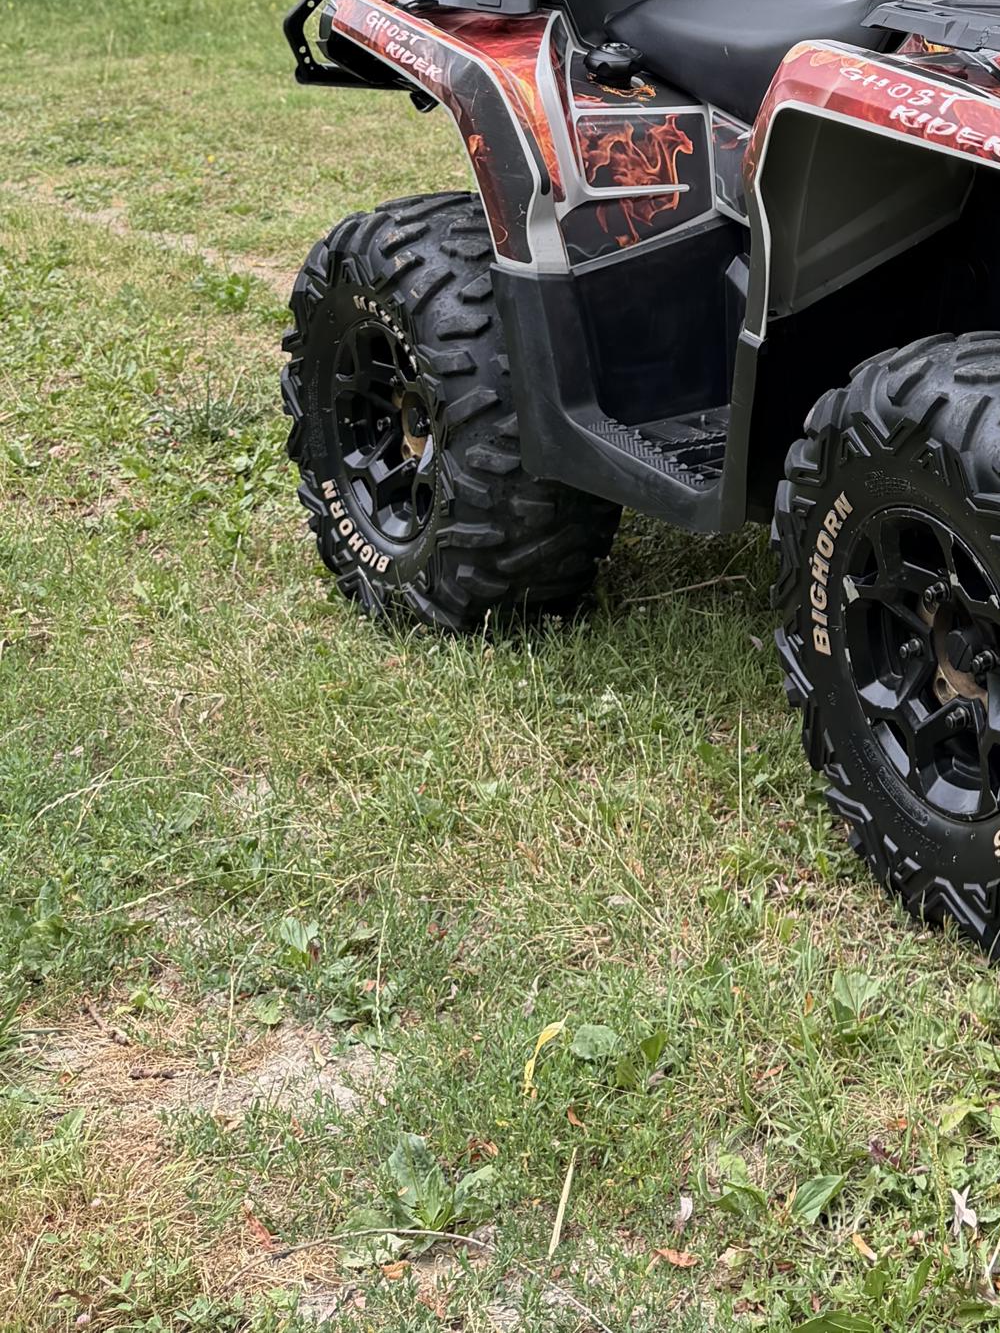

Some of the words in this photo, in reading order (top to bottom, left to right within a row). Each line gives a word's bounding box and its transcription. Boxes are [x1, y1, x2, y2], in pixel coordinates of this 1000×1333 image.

[366, 10, 428, 46] GHOST
[385, 41, 442, 83] RIDER
[839, 67, 977, 115] GHOST
[321, 479, 391, 573] BIGHORN
[809, 490, 854, 656] BIGHORN
